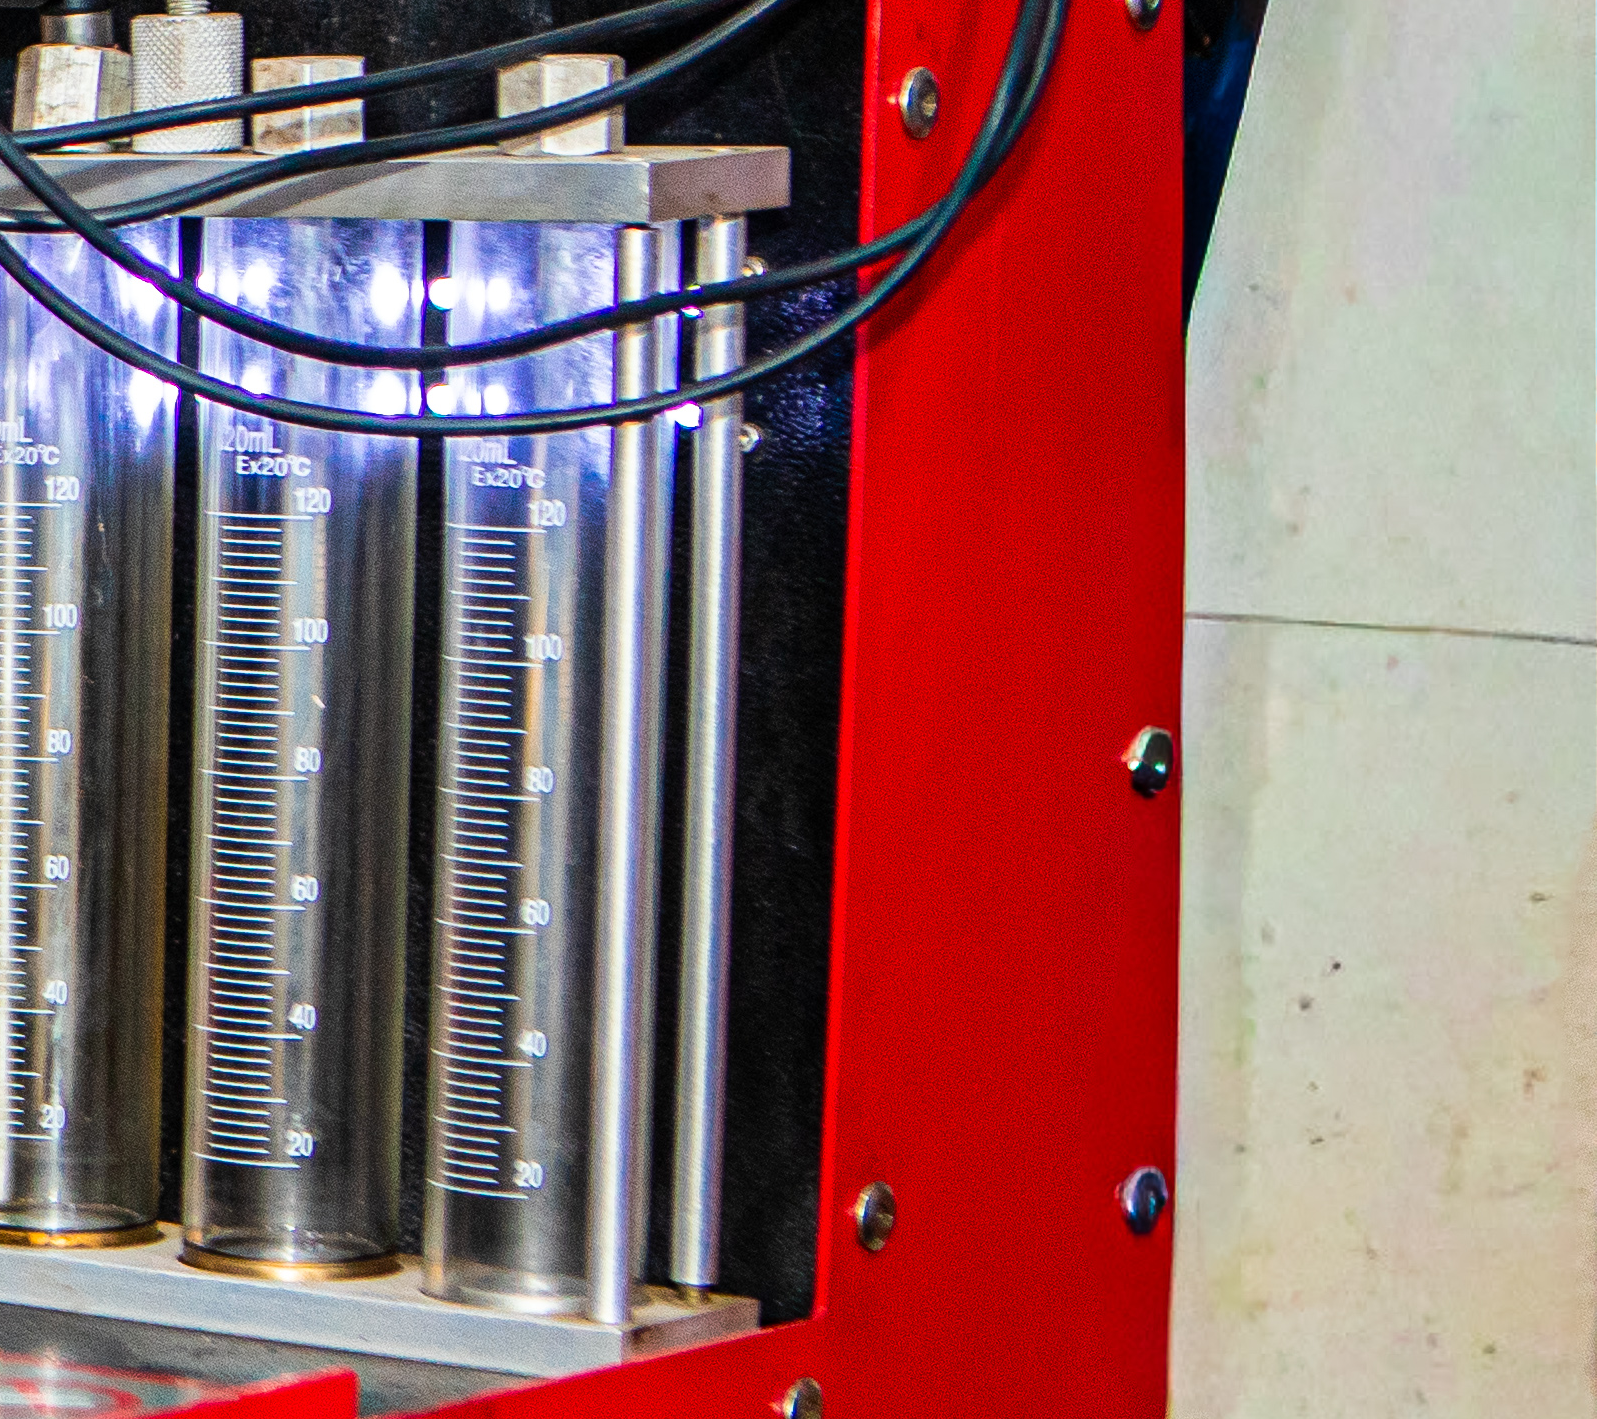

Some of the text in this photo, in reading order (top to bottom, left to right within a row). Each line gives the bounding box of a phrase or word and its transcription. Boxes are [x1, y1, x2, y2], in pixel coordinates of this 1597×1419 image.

[44, 476, 79, 501] 120
[293, 487, 332, 514] 120
[528, 500, 567, 527] 120
[42, 604, 78, 628] 100
[292, 618, 329, 643] 100
[523, 634, 562, 661] 100
[46, 729, 71, 754] 80
[294, 747, 321, 773] 80
[524, 766, 555, 793] 80
[44, 855, 69, 879] 60
[291, 875, 319, 901] 60
[520, 899, 550, 926] 60
[42, 981, 68, 1004] 40
[288, 1002, 316, 1029] 40
[518, 1029, 548, 1057] 40
[40, 1105, 66, 1129] 20
[286, 1129, 314, 1156] 20
[513, 1160, 544, 1188] 20
